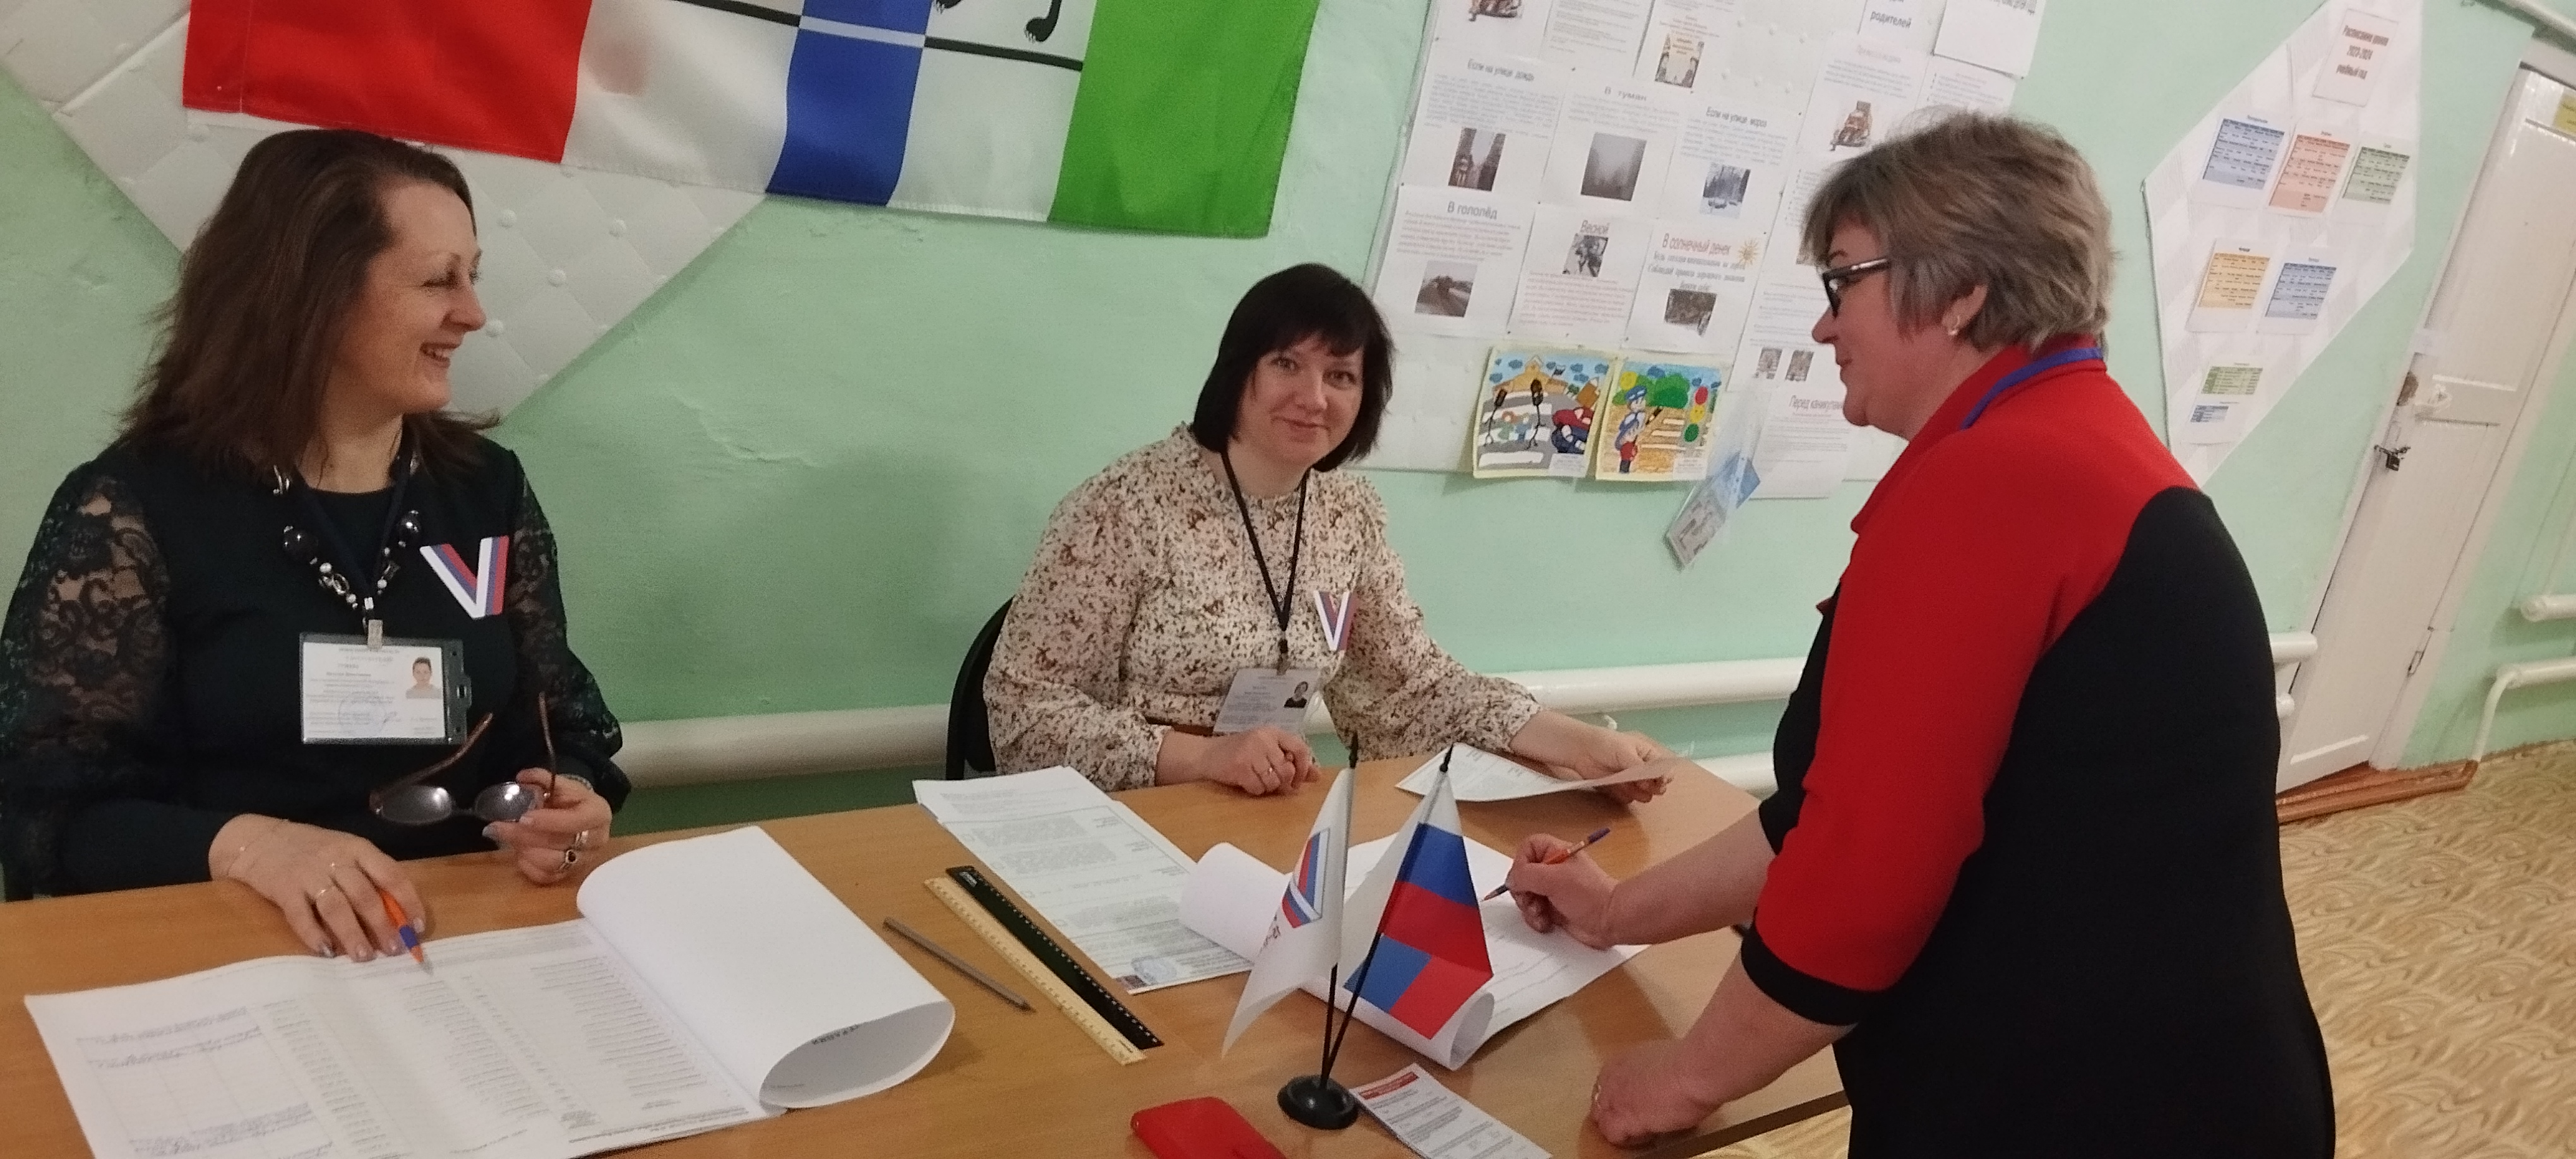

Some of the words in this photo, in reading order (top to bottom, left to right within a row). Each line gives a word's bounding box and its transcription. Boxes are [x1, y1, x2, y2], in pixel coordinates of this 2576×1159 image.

[1869, 11, 1912, 29] родителей
[1618, 90, 1647, 101] туман
[1447, 201, 1455, 213] В
[1580, 220, 1610, 235] Весной
[1662, 232, 1669, 247] В
